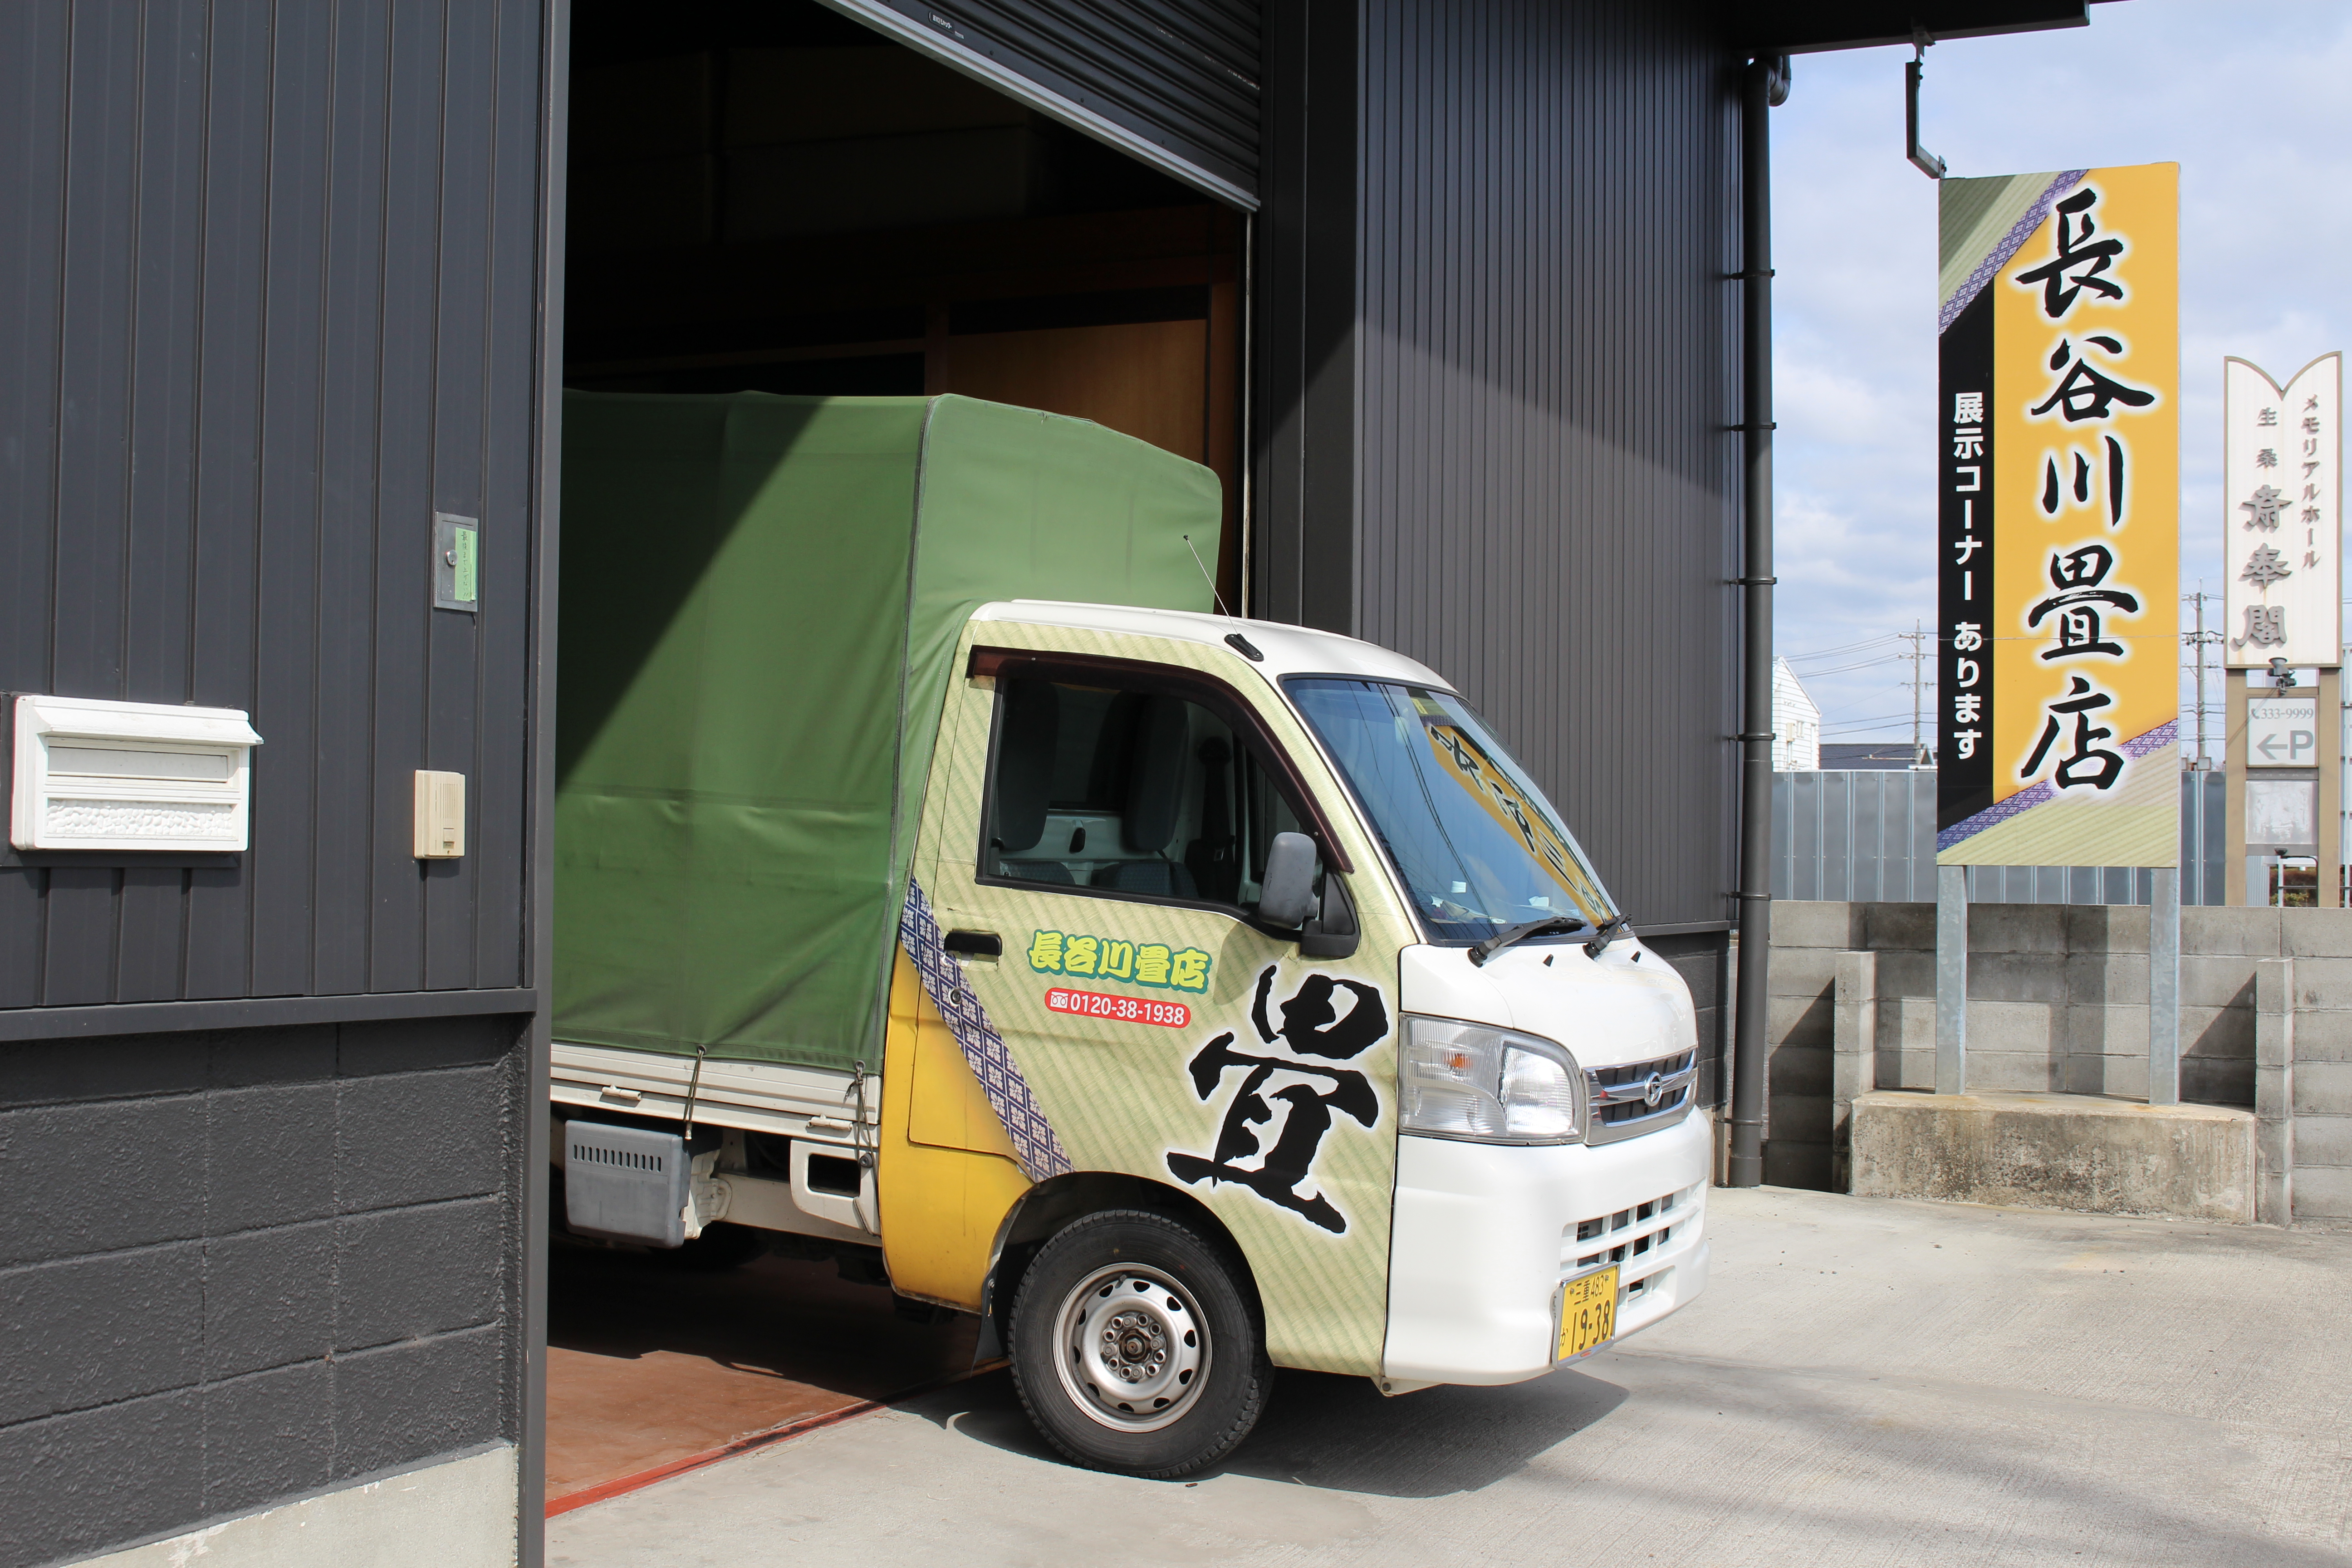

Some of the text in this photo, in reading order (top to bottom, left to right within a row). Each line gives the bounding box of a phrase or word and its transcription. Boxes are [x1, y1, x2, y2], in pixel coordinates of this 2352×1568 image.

[2015, 187, 2154, 790] 長谷川畳店
[2301, 394, 2321, 569] メモリアルホール
[1953, 392, 1984, 760] 展示コーナー あります
[2261, 708, 2314, 720] 333-9999
[2290, 730, 2314, 760] P
[1029, 931, 1210, 990] 長谷川畳店
[1070, 993, 1185, 1025] 0120-38-1938
[1167, 965, 1389, 1234] 畳
[1573, 1274, 1604, 1305] 三重 483
[1571, 1299, 1610, 1354] 19-38
